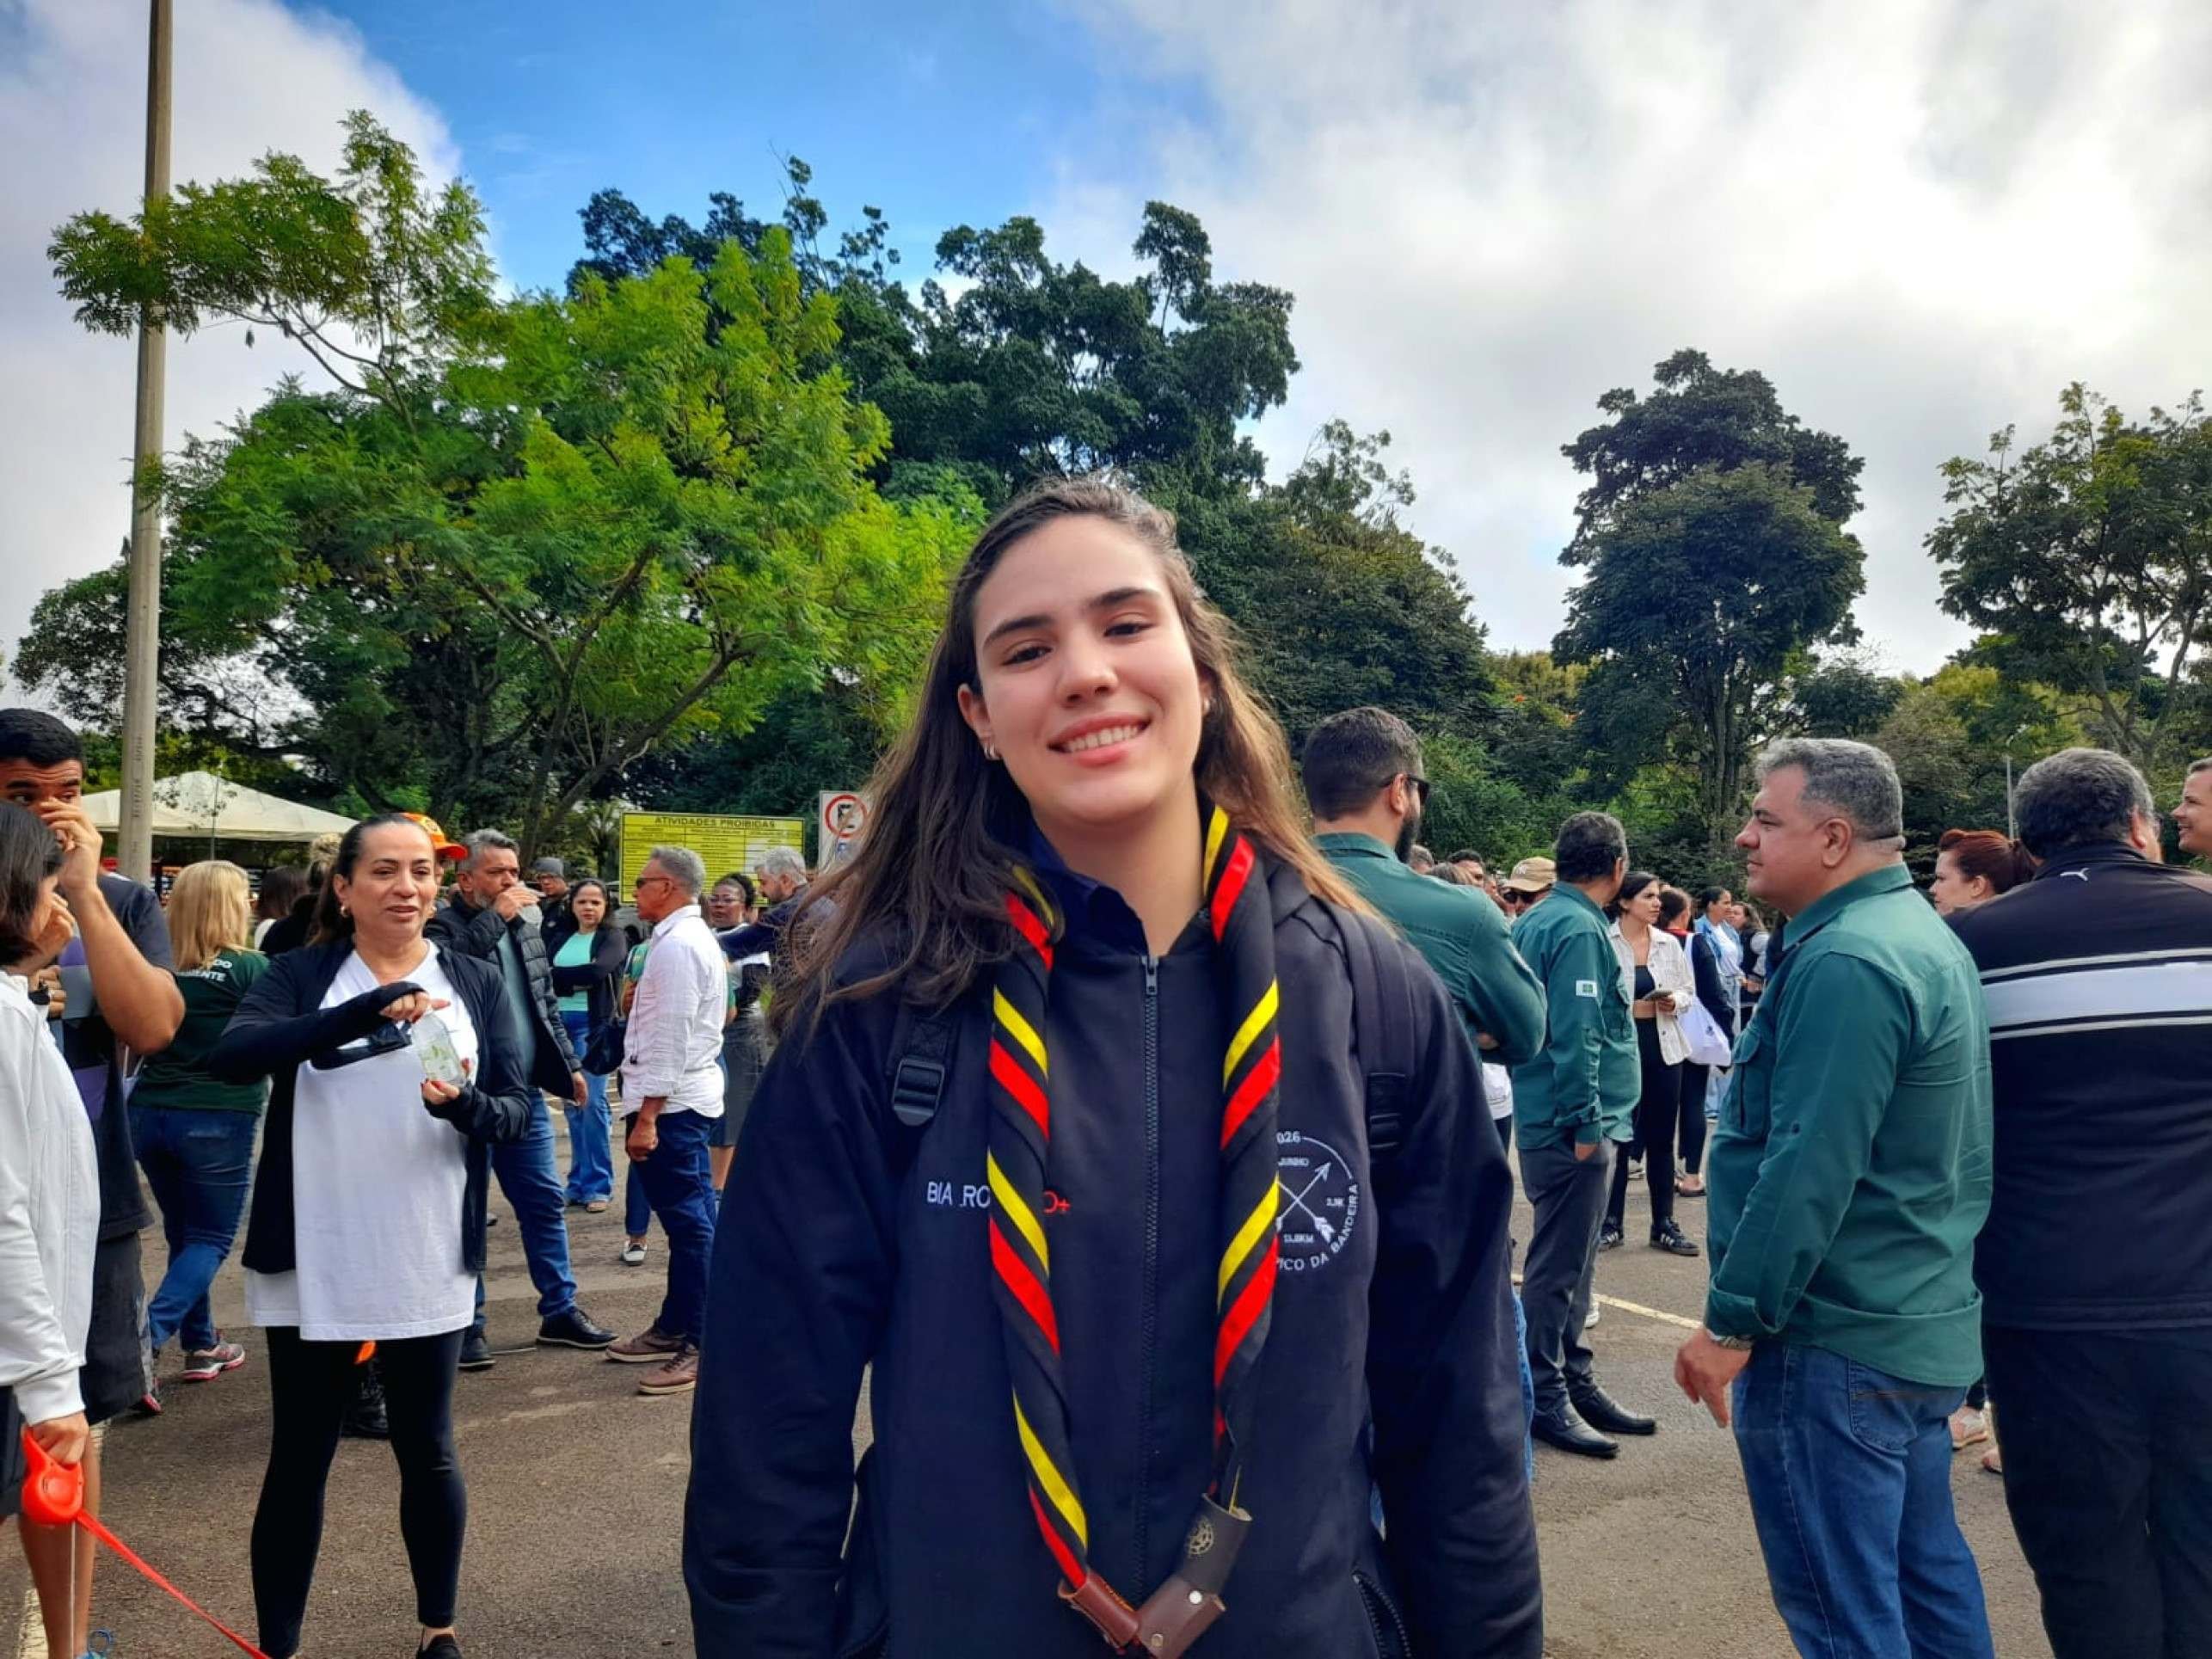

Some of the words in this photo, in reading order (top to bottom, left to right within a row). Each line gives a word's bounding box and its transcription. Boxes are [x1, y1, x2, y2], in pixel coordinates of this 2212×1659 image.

[654, 816, 716, 827] ATIVIDADES
[720, 819, 776, 829] PROIBIDAS
[927, 1181, 952, 1206] BIA
[1276, 1257, 1305, 1271] ICO
[1310, 1252, 1330, 1269] DA
[1331, 1183, 1358, 1254] BANDEIRA
